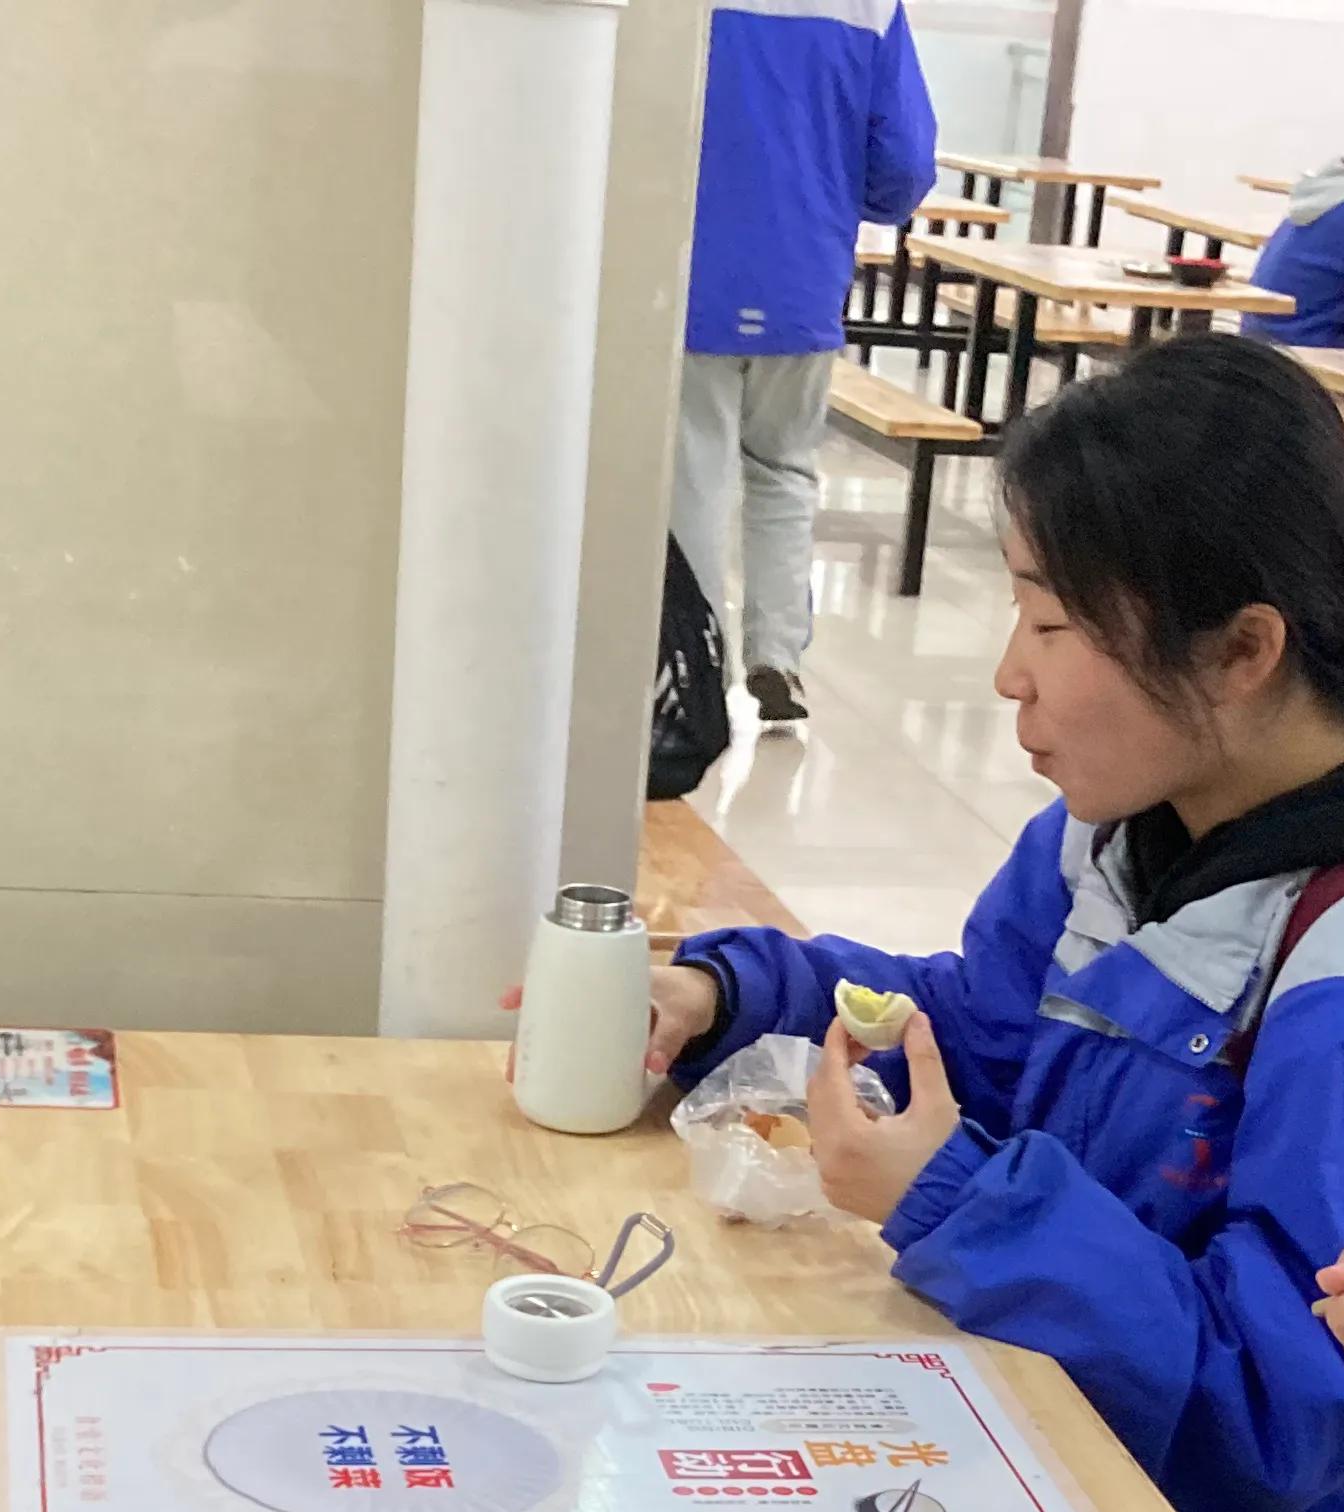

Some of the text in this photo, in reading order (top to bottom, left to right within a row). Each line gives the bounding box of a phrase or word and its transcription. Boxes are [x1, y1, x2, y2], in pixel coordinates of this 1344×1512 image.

[317, 1424, 382, 1488] 不剩菜
[390, 1424, 454, 1488] 不剩饭
[671, 1439, 949, 1478] 光盘行动
